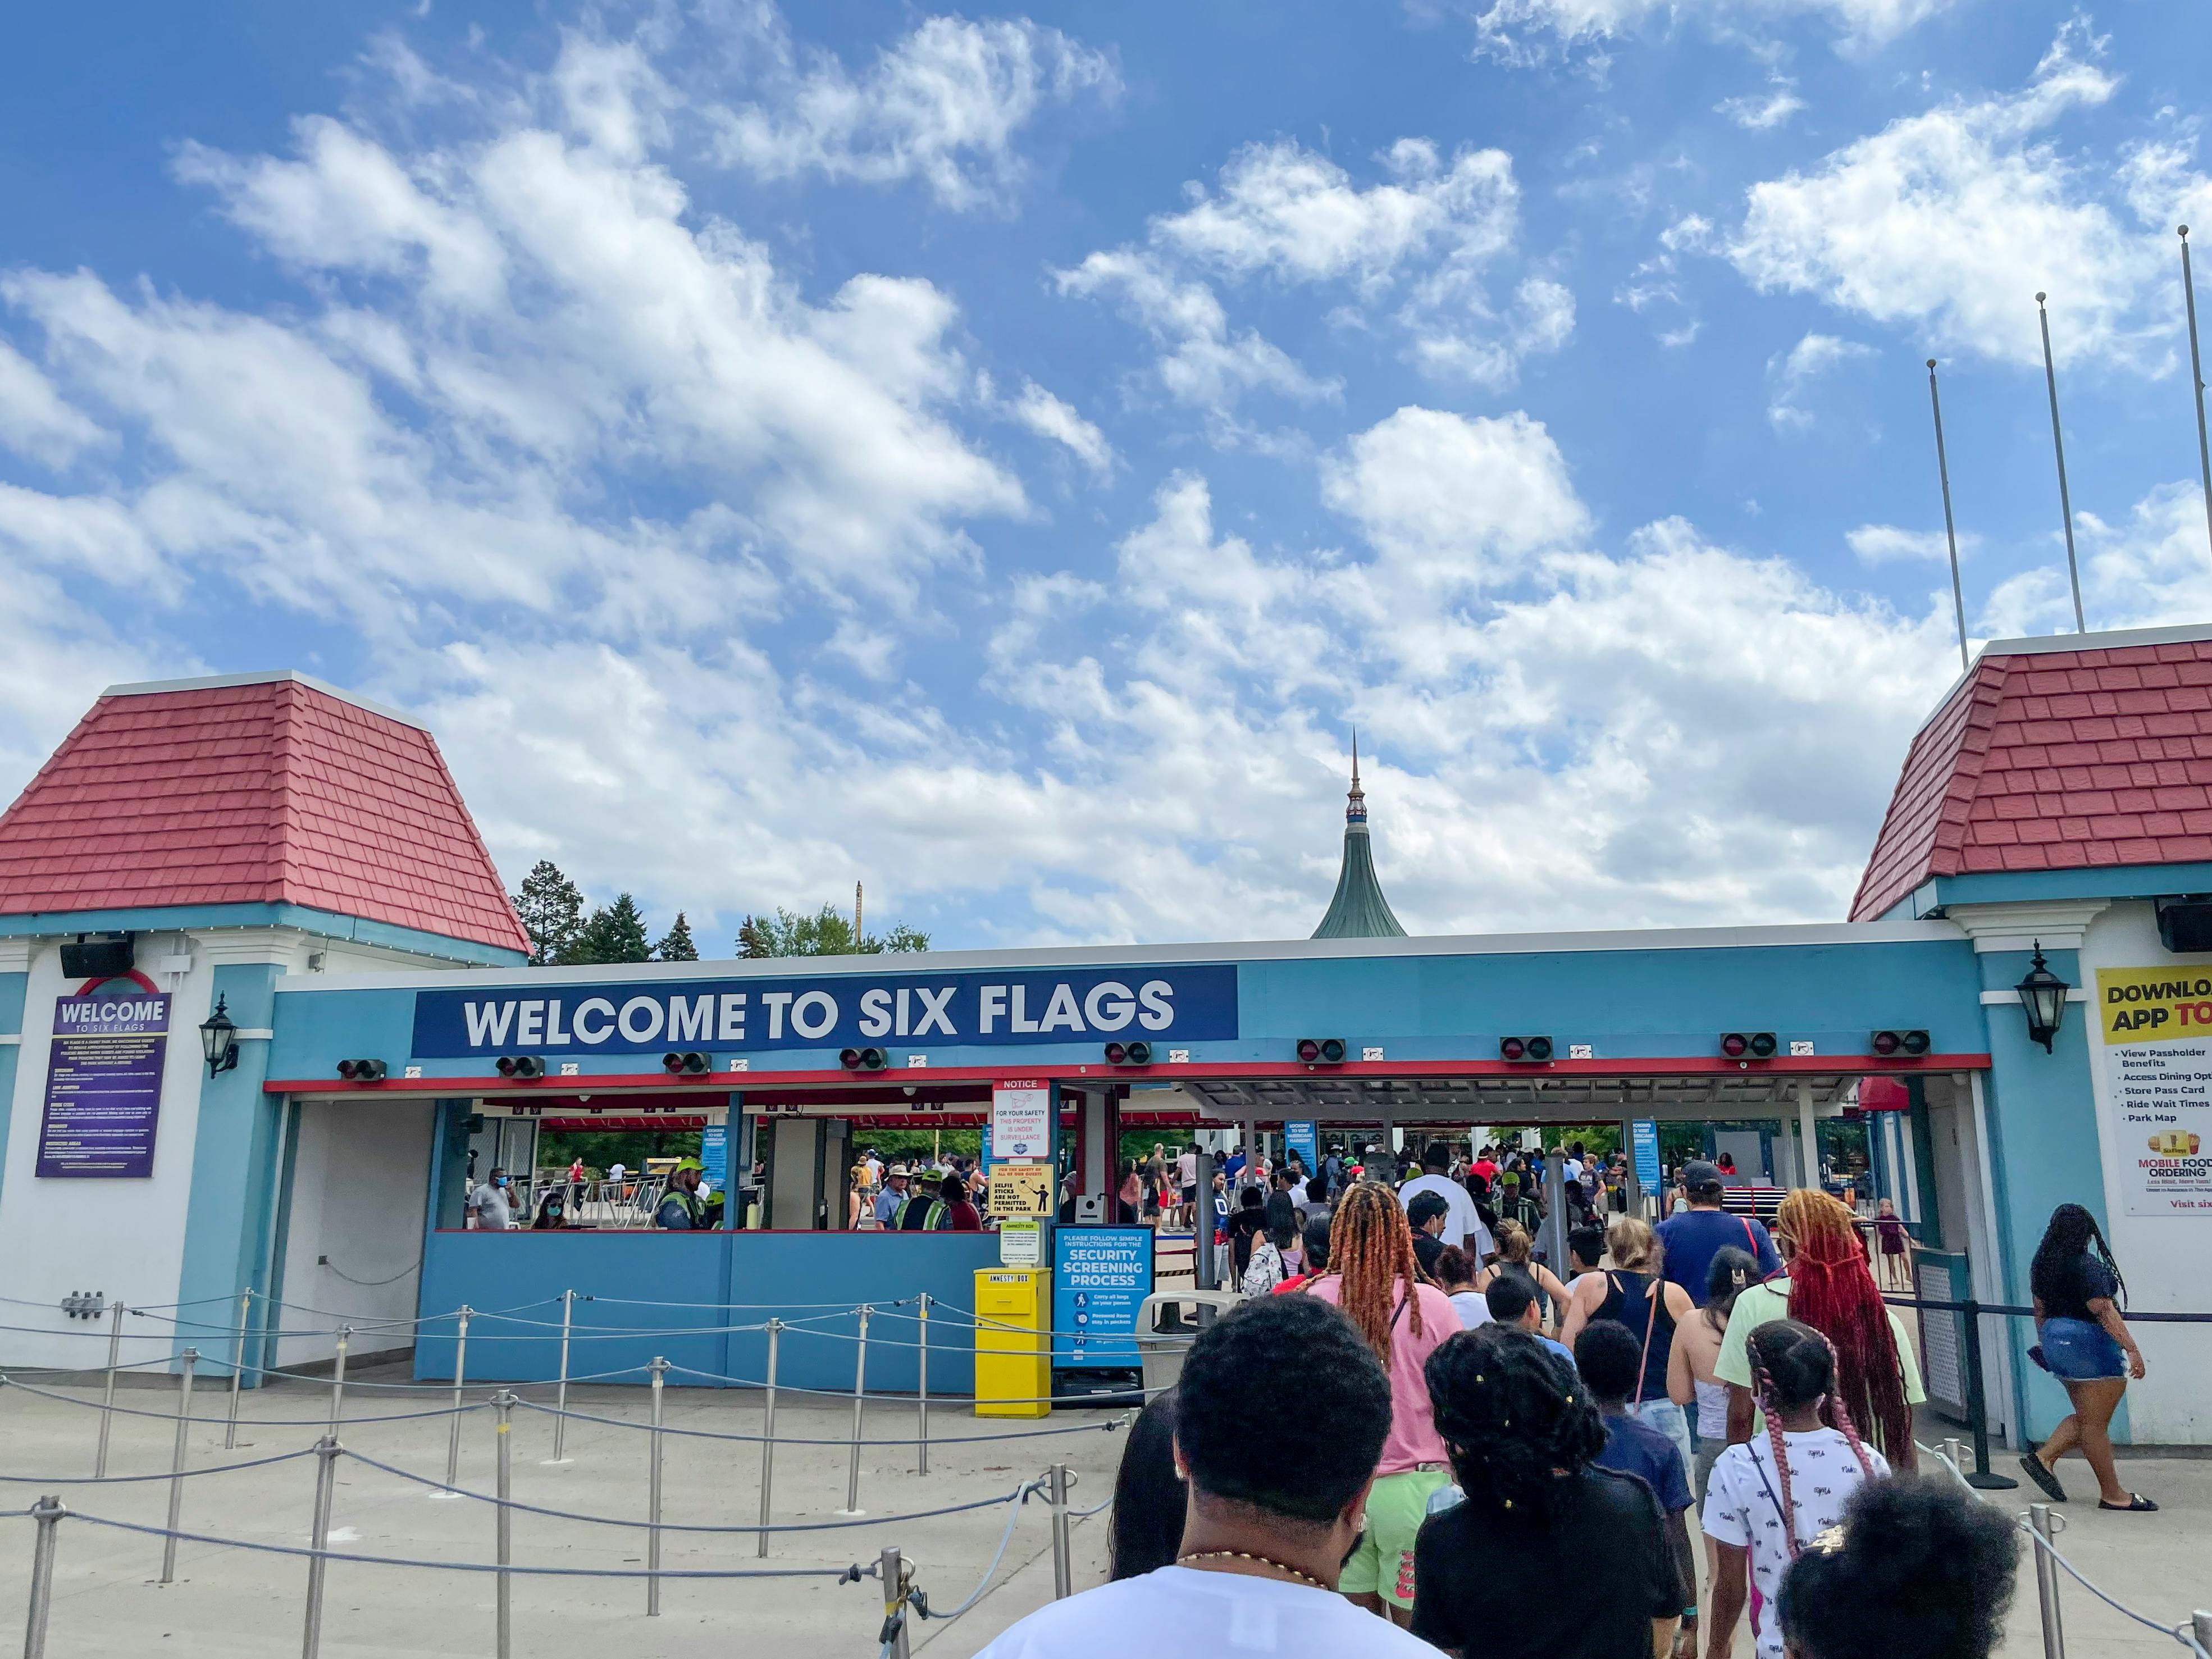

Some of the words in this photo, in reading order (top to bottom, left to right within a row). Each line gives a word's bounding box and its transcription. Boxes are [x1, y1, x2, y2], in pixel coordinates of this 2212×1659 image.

[2108, 979, 2212, 1004] DOWNLO
[61, 1000, 165, 1023] WELCOME
[464, 993, 747, 1047] WELCOME
[761, 991, 838, 1040] TO
[859, 987, 958, 1037] SIX
[979, 979, 1174, 1033] FLAGS
[2111, 1008, 2169, 1032] APP
[76, 1024, 88, 1033] TO
[93, 1024, 110, 1032] SIX
[113, 1023, 145, 1032] FLAGS
[2120, 1049, 2147, 1058] View
[2149, 1049, 2206, 1057] Passholder
[2122, 1059, 2166, 1068] Benefits
[2159, 1072, 2192, 1082] Dining
[2193, 1072, 2212, 1081] Opt
[1004, 1080, 1037, 1088] NOTICE
[2152, 1100, 2177, 1108] Wait
[2178, 1099, 2210, 1107] Times
[2128, 1114, 2152, 1122] Park
[2155, 1114, 2177, 1123] Map
[2138, 1159, 2180, 1168] MOBILE
[2183, 1159, 2212, 1168] FOOD
[2149, 1168, 2206, 1177] ORDERING
[2170, 1200, 2196, 1208] Visit
[1069, 1249, 1137, 1261] SECURITY
[1063, 1262, 1143, 1274] SCREENING
[1070, 1274, 1135, 1286] PROCESS
